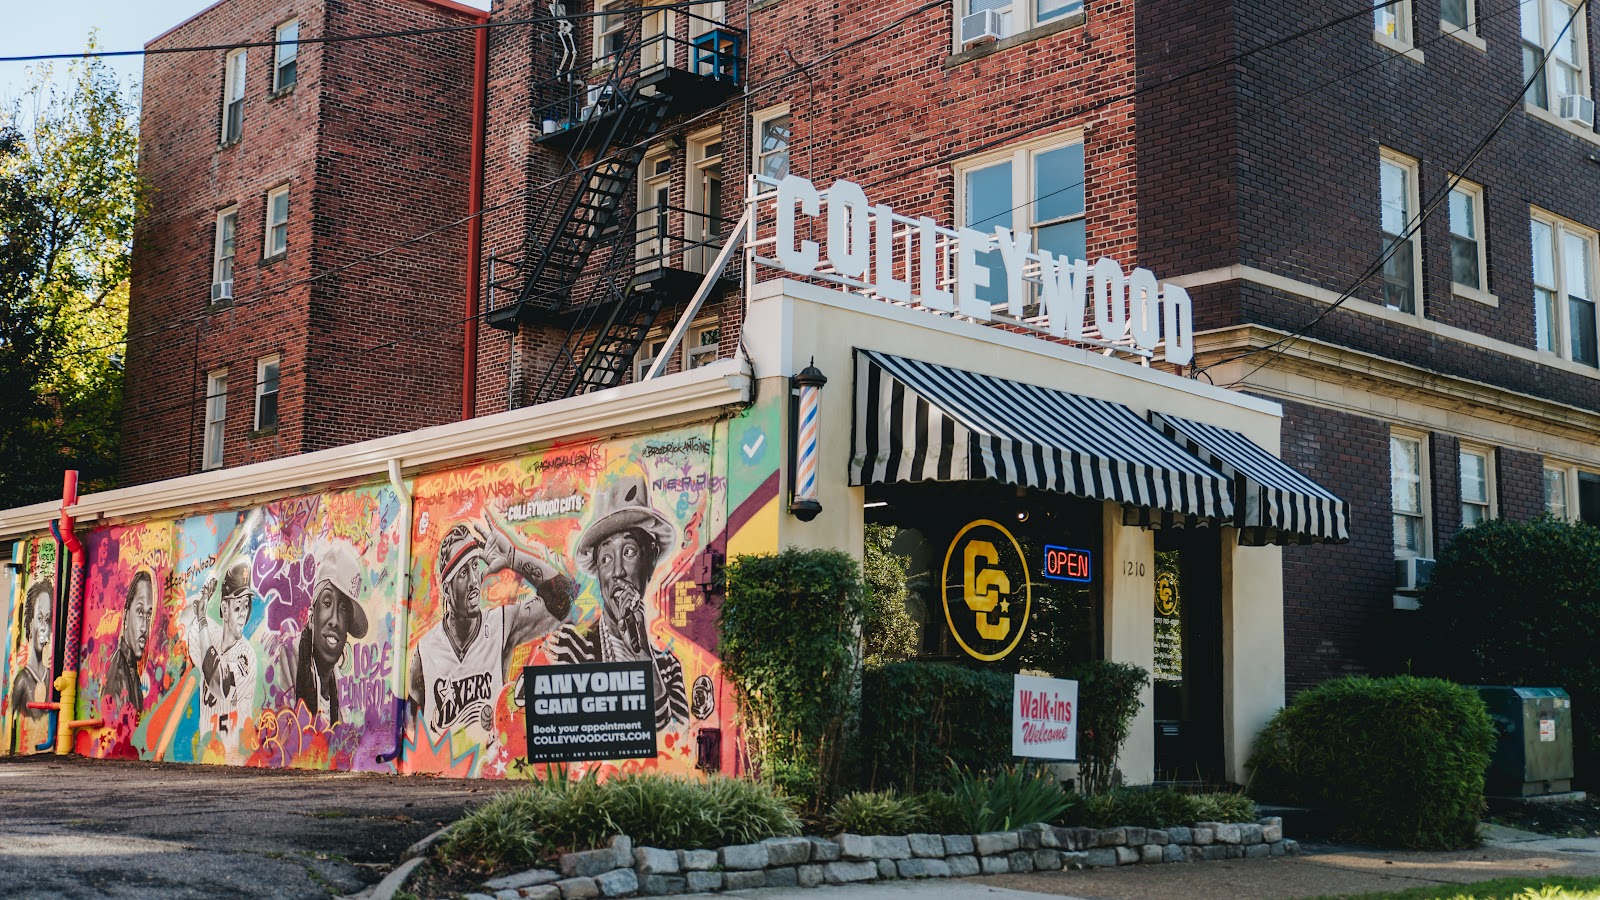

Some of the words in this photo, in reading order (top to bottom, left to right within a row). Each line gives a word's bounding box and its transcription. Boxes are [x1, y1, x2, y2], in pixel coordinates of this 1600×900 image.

[776, 175, 1193, 365] COLLEYWOOD
[508, 498, 559, 520] COLLEYWOOD
[561, 495, 583, 513] CUTS
[1047, 550, 1088, 577] OPEN
[1122, 560, 1146, 577] 1210
[534, 670, 646, 695] ANYONE
[534, 697, 578, 715] CAN
[581, 696, 618, 713] GET
[621, 694, 647, 711] IT!
[1020, 689, 1072, 723] Walk-ins
[533, 724, 557, 734] Book
[558, 725, 580, 735] your
[580, 721, 642, 734] appointment
[533, 731, 651, 746] COLLEYWOODCUTS.COM
[1021, 721, 1068, 745] Welcome
